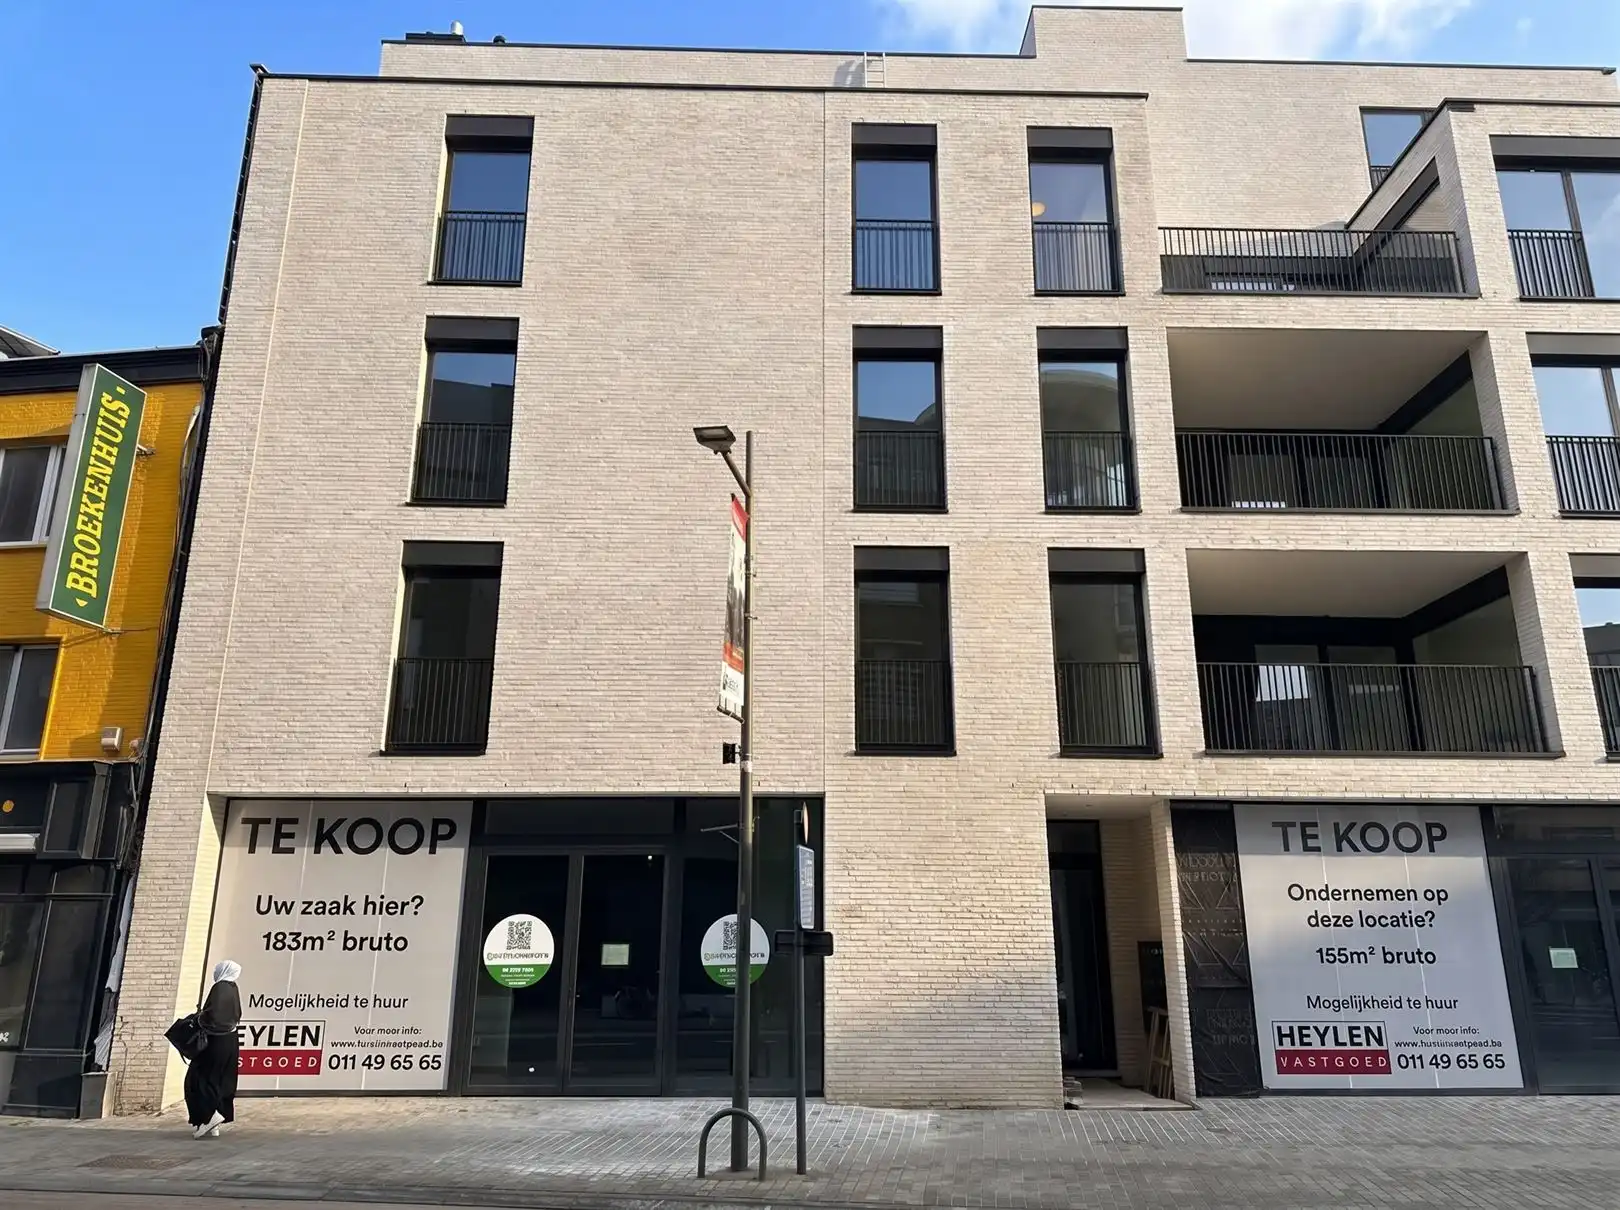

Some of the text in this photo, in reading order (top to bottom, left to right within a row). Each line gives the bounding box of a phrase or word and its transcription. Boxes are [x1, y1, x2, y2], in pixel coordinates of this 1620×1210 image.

[65, 392, 131, 599] BROEKENHUIS
[241, 817, 457, 855] TE KOOP
[1271, 822, 1448, 853] TE KOOP
[1287, 883, 1449, 905] Ondernemen op
[255, 895, 425, 915] Uw zaak hier?
[1307, 910, 1436, 928] deze locatie?
[262, 930, 409, 951] 183m² bruto
[1315, 946, 1437, 965] 155m² bruto
[248, 993, 409, 1012] Mogelijkheid te huur
[1306, 995, 1459, 1012] Mogelijkheid te huur
[237, 1025, 321, 1047] EYLEN
[401, 1026, 422, 1035] info:
[1276, 1025, 1385, 1047] HEYLEN
[1460, 1026, 1480, 1035] info:
[237, 1056, 317, 1068] STGOED
[328, 1054, 442, 1070] 011 49 65 65
[1280, 1057, 1387, 1068] VASTGOED
[1397, 1053, 1506, 1069] 011 49 65 65
